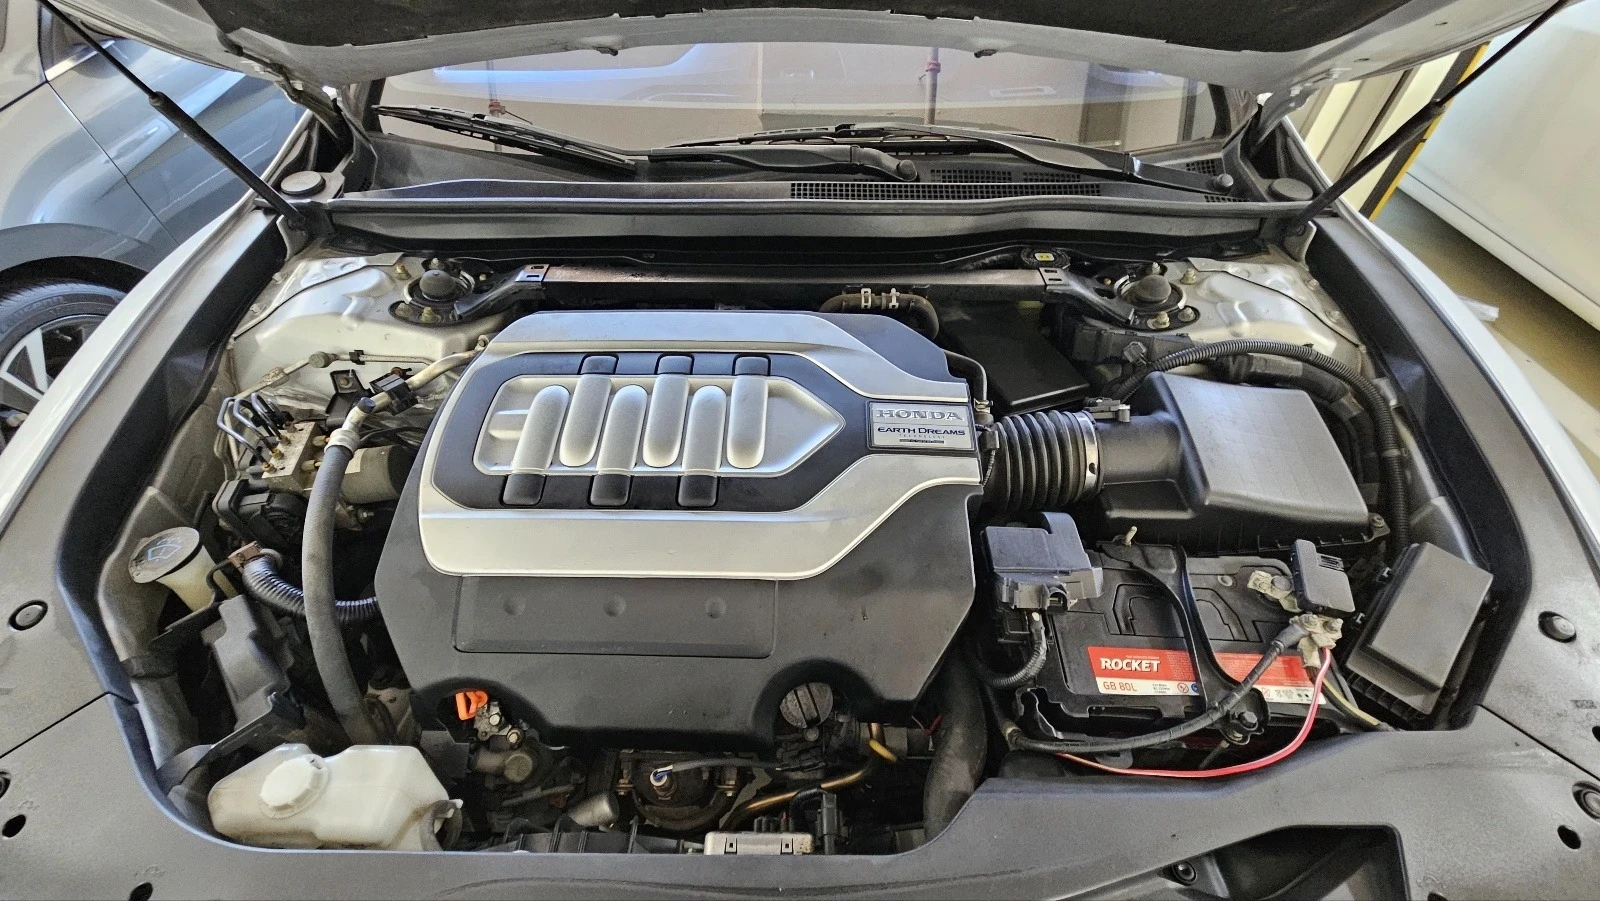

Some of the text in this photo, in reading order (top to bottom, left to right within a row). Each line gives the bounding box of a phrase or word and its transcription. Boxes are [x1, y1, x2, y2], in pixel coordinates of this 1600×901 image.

[877, 409, 964, 420] HONDA
[918, 427, 966, 436] DREAMS
[1100, 657, 1161, 672] ROCKET
[1103, 681, 1137, 692] GB 80L
